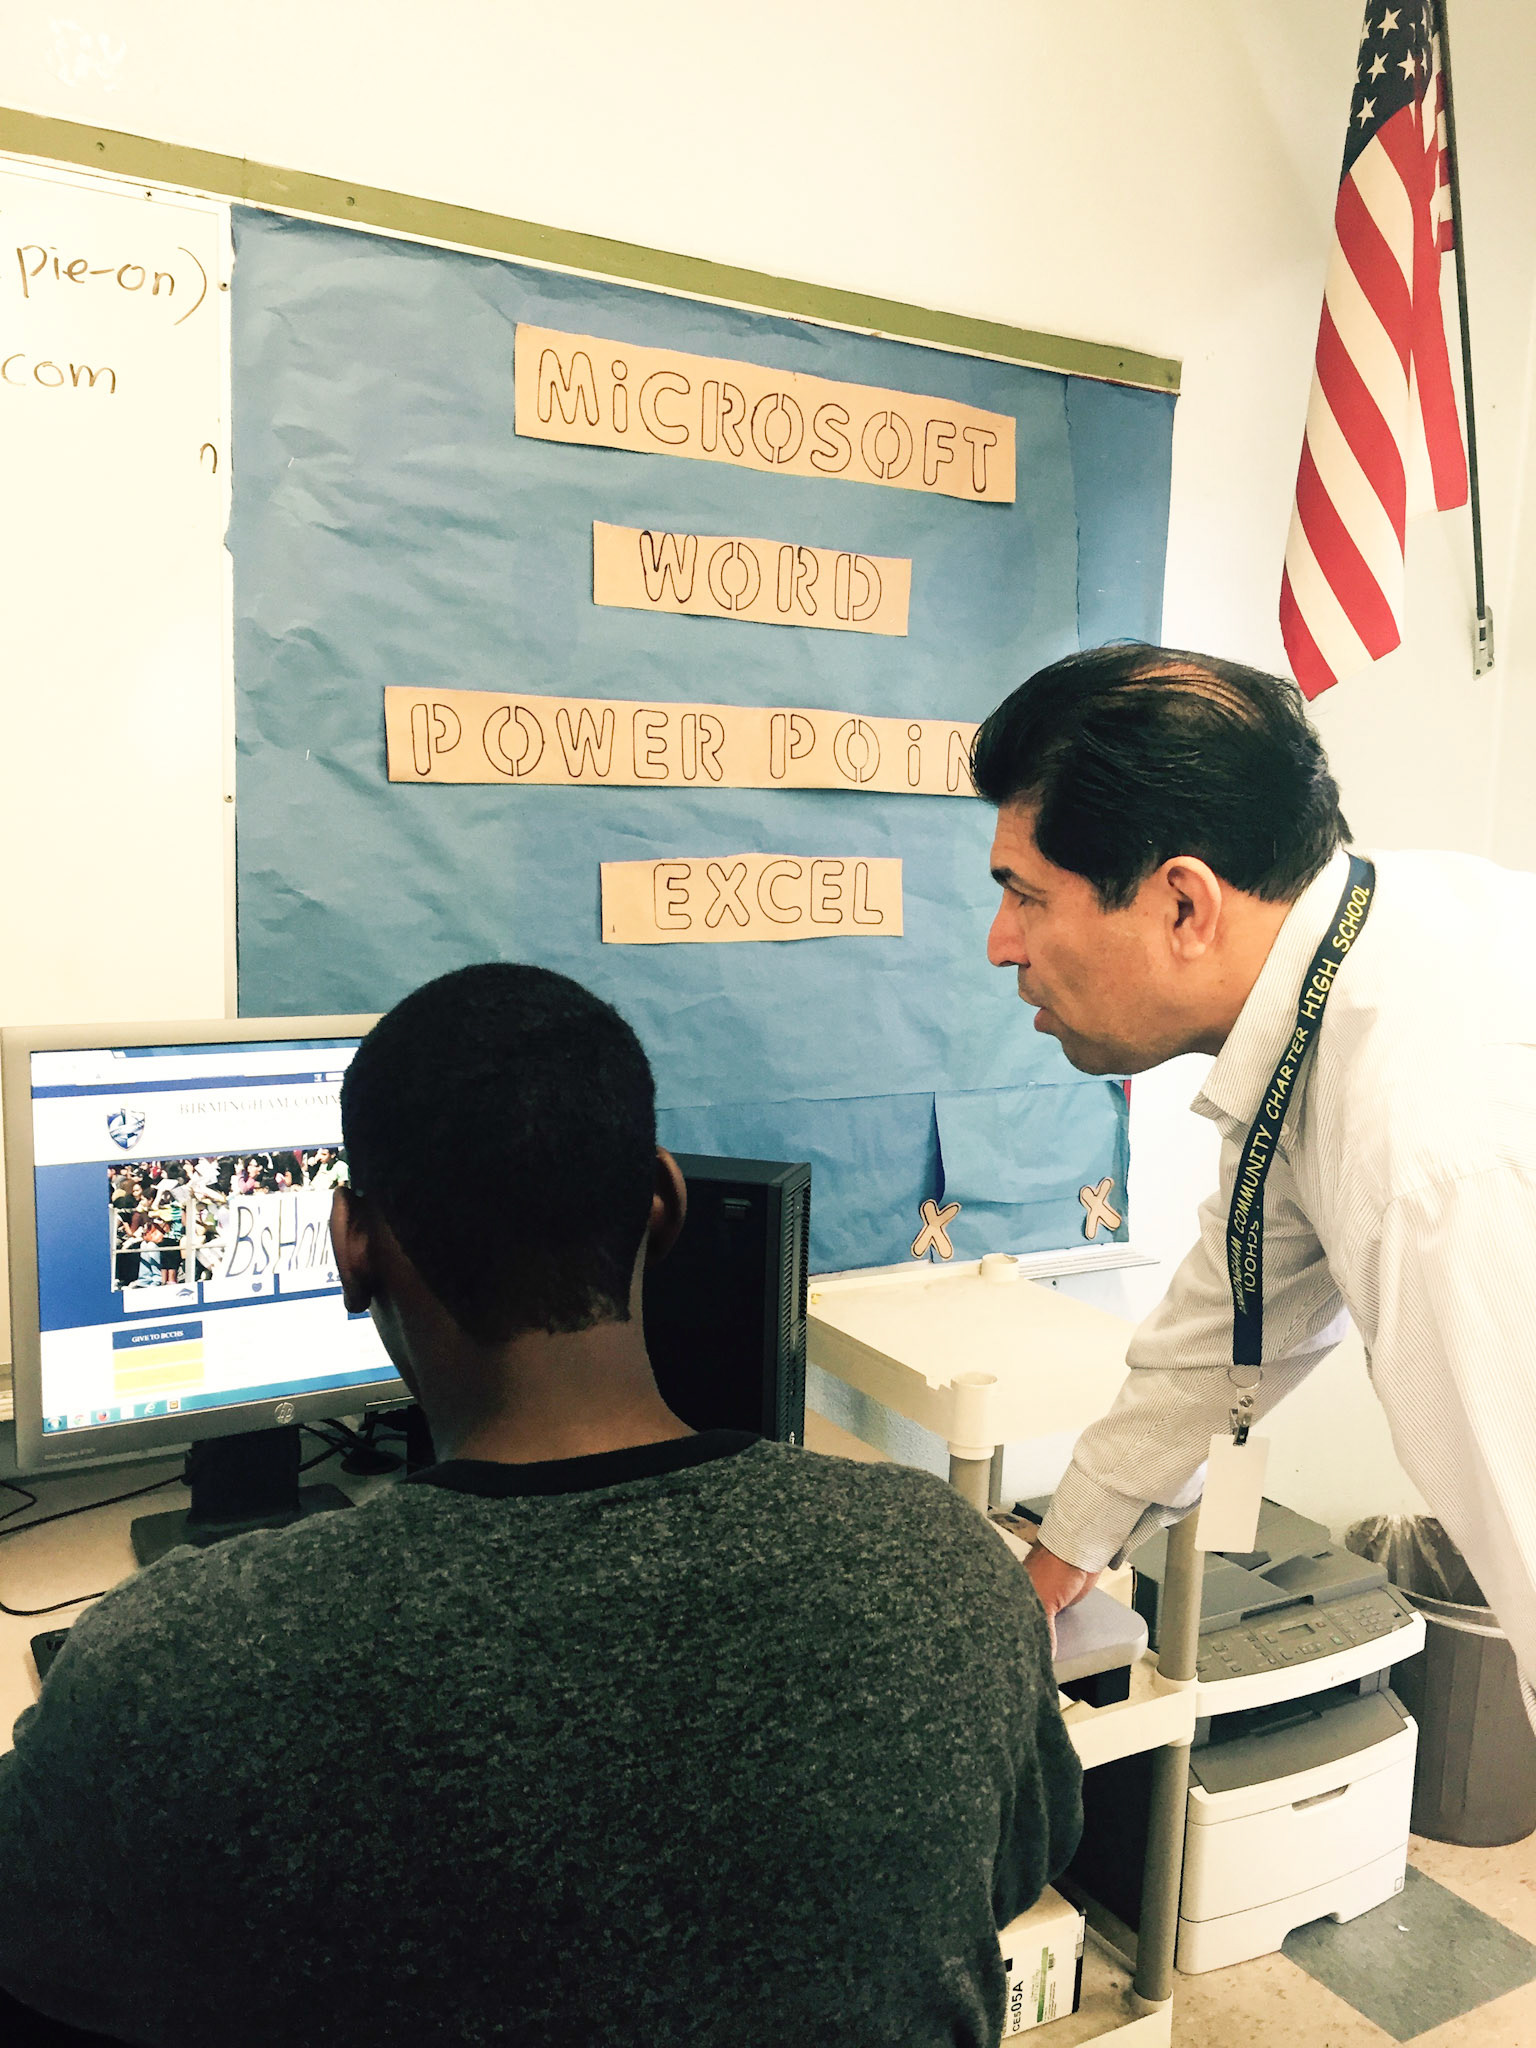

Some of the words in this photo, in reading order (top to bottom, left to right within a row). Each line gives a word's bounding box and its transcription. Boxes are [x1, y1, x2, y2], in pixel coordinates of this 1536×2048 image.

[638, 530, 882, 622] WORD
[410, 702, 726, 782] POWER
[652, 858, 884, 930] EXCEL
[1233, 1123, 1274, 1235] COMMUNITY
[1264, 1026, 1310, 1121] CHARTER
[1300, 957, 1341, 1021] HIGH
[1332, 884, 1371, 954] SCHOOL
[180, 1097, 289, 1114] BIRMINGHAM
[131, 1334, 150, 1343] GIVE
[150, 1333, 160, 1341] TO
[1010, 1980, 1023, 2031] CE505A
